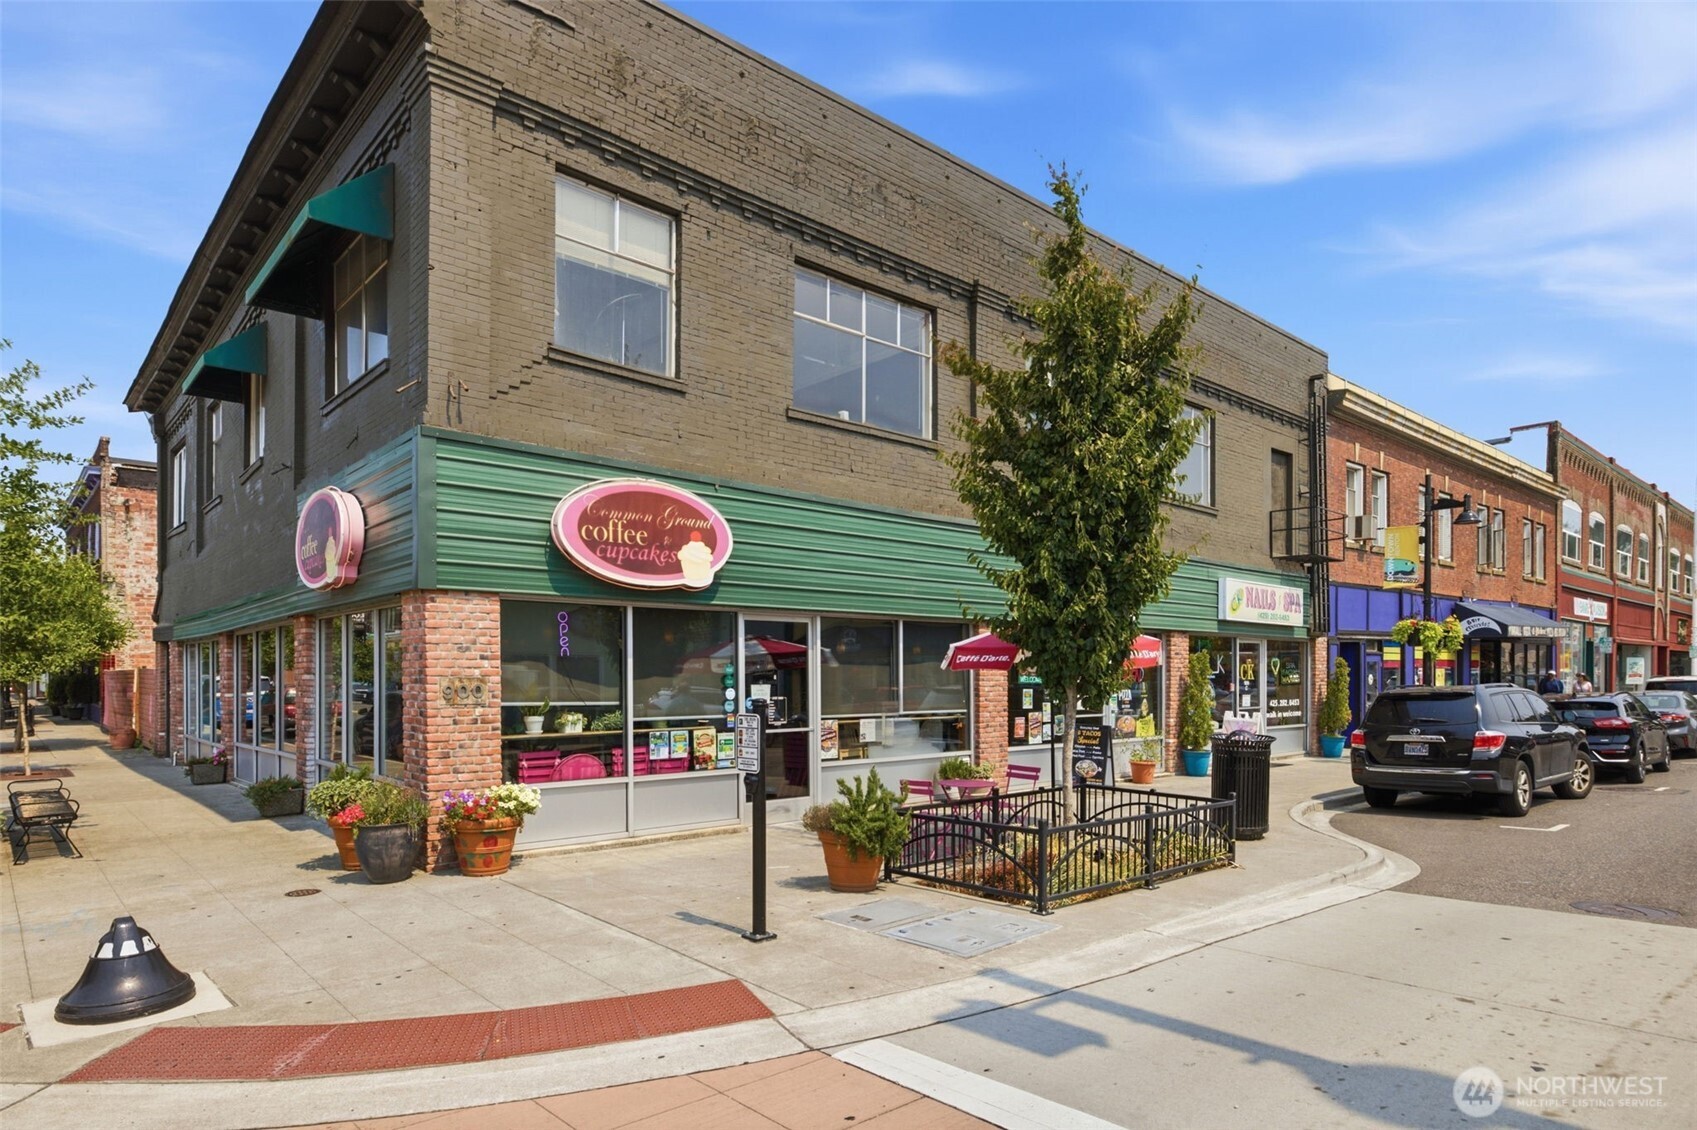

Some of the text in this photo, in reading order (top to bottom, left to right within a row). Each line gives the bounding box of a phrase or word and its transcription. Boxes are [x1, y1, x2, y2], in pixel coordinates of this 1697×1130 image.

[584, 493, 715, 530] Common Ground
[581, 519, 648, 546] coffee
[596, 543, 678, 567] cupcakes
[1245, 586, 1302, 614] NAILS SPA
[443, 683, 484, 700] 900
